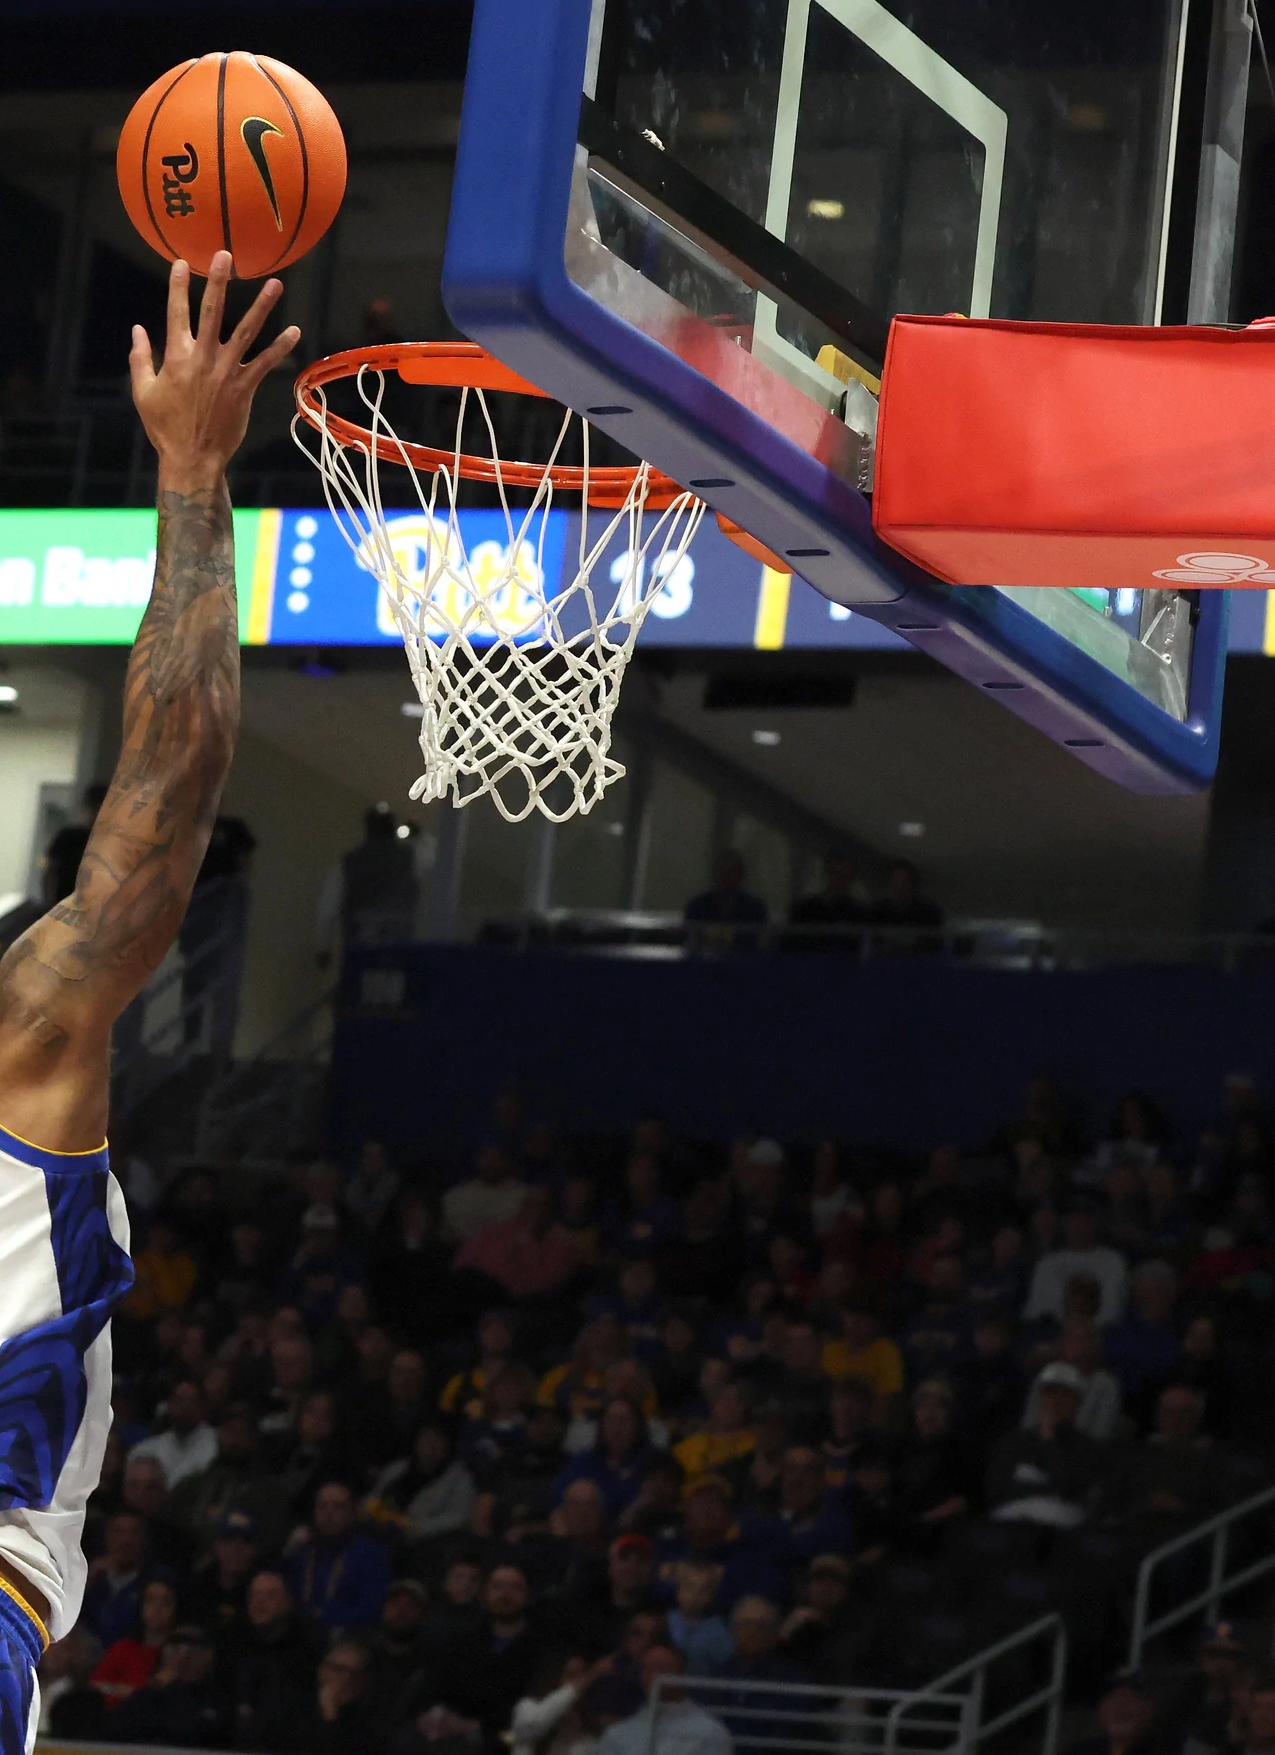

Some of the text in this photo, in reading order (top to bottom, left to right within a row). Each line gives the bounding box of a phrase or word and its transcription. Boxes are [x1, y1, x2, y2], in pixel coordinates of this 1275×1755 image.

[161, 142, 198, 219] Pitt
[42, 546, 154, 607] Ban
[356, 514, 544, 637] Pitt
